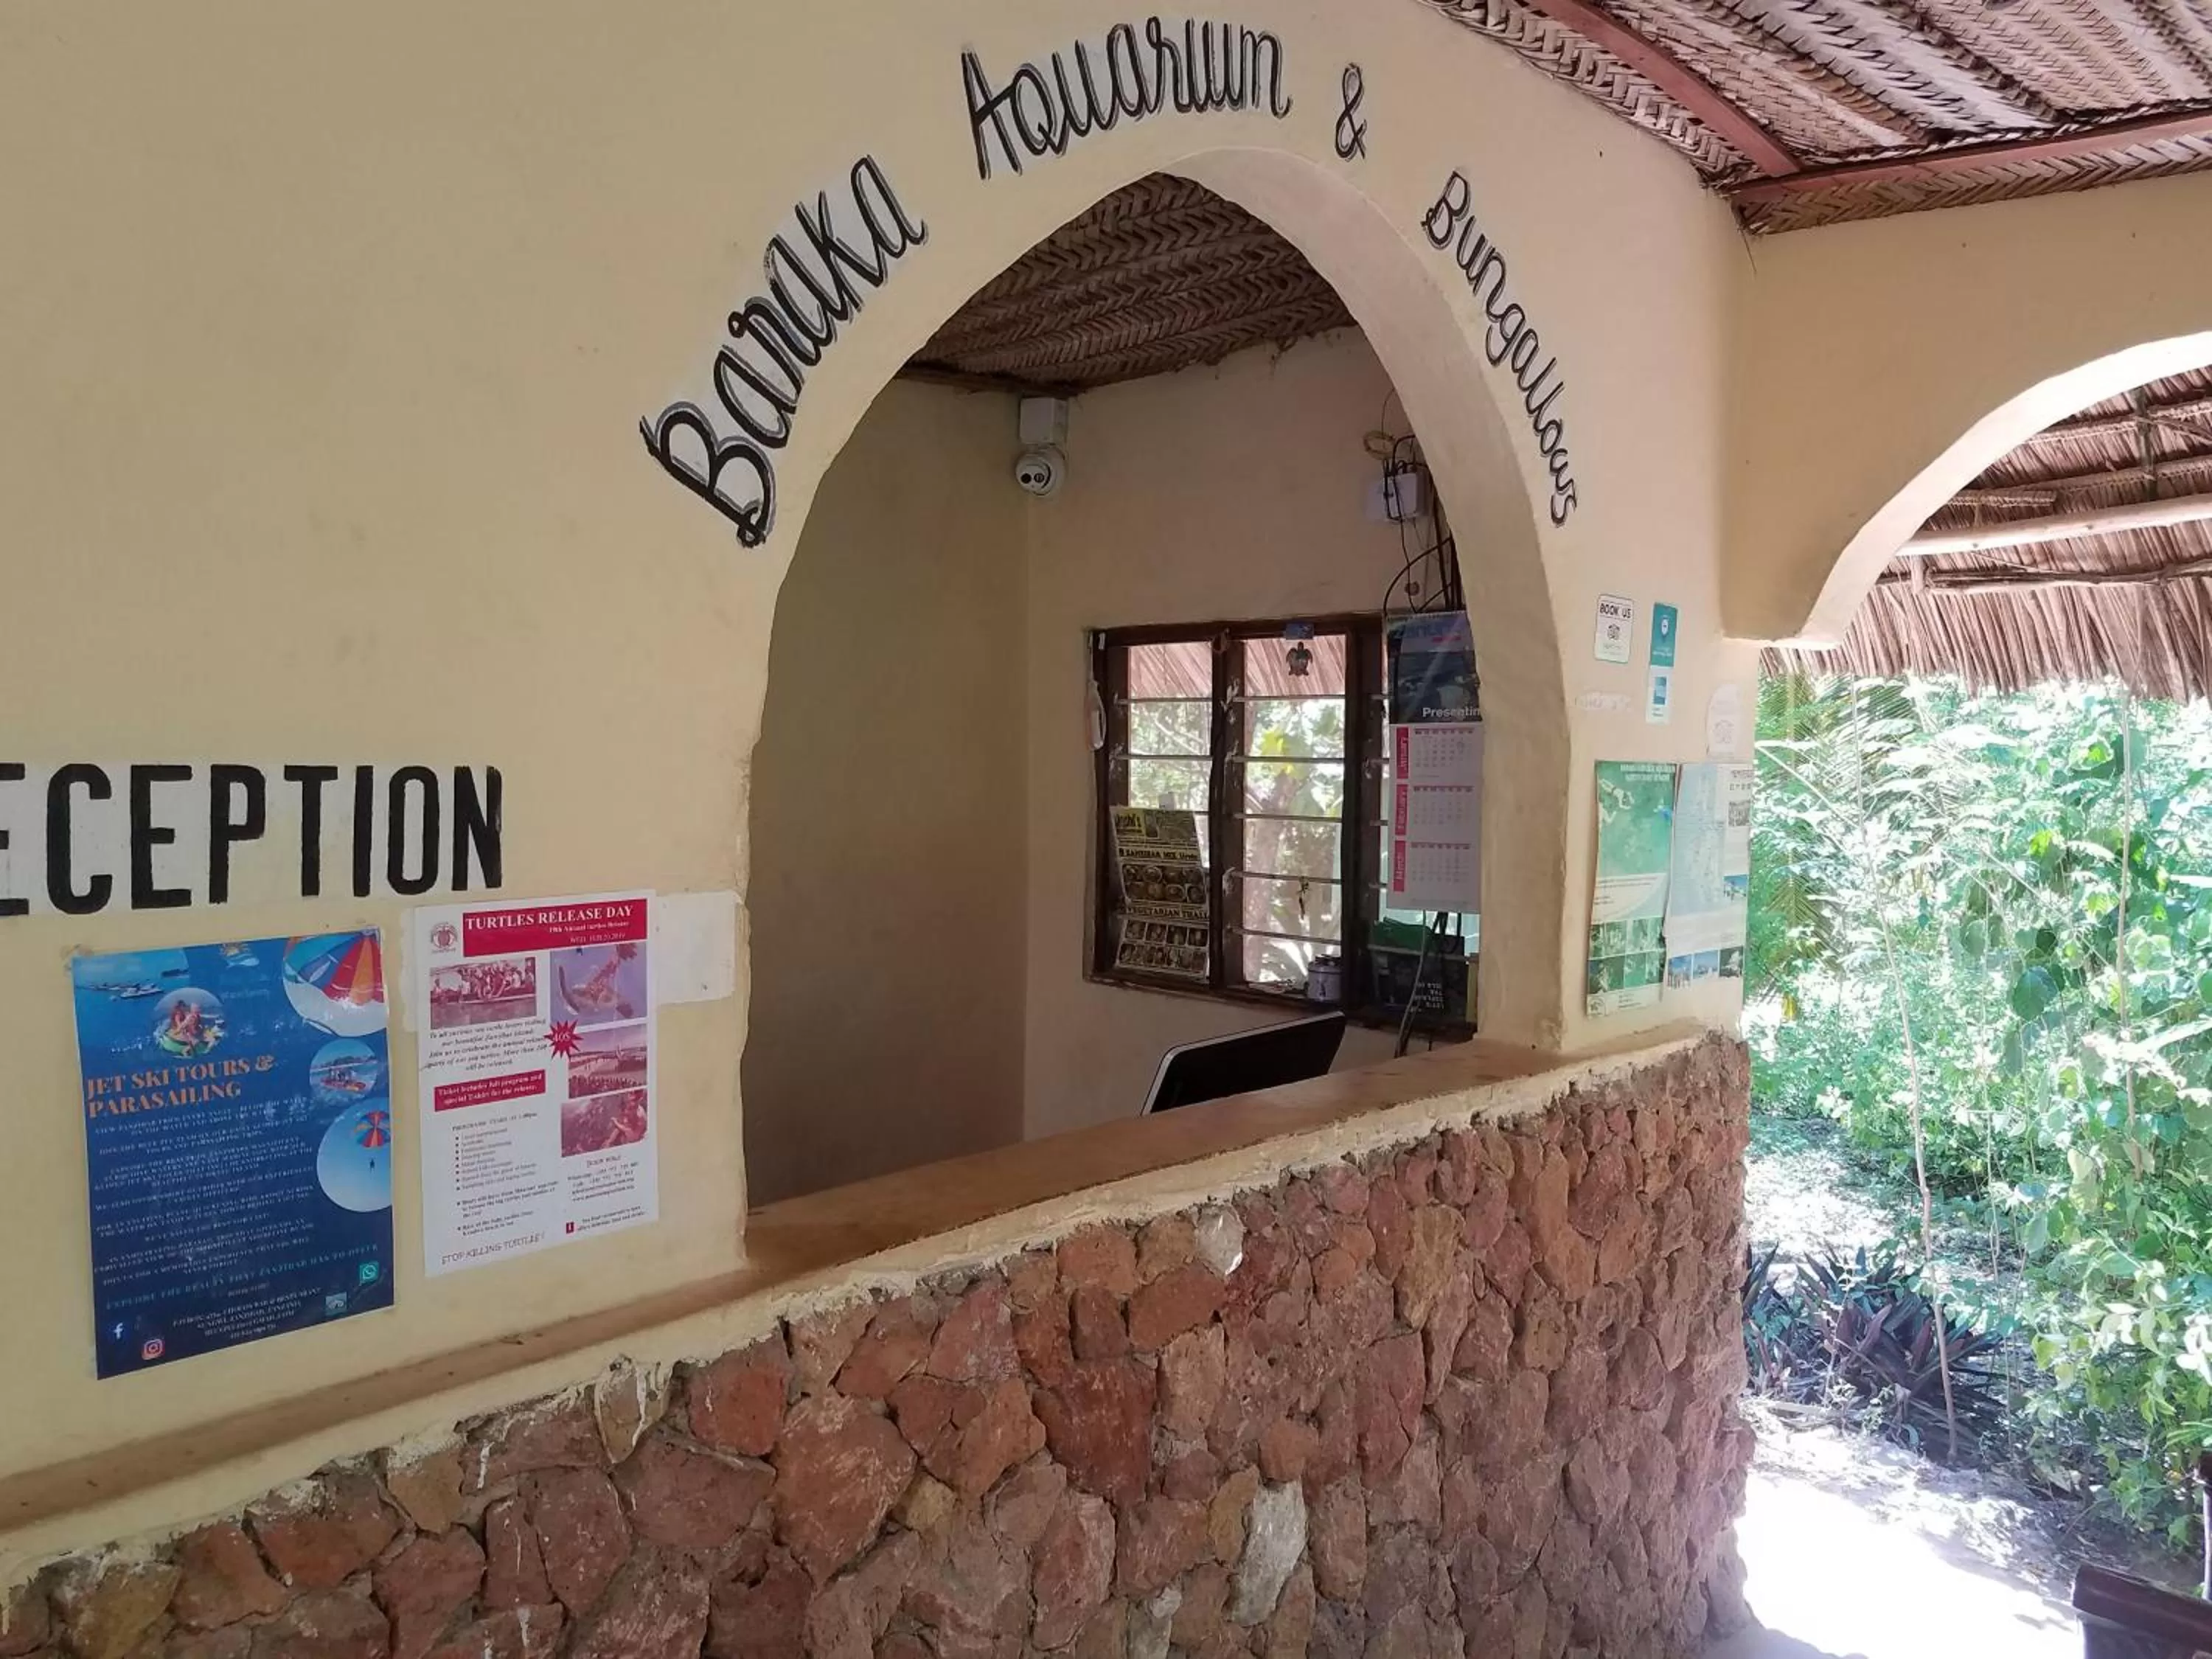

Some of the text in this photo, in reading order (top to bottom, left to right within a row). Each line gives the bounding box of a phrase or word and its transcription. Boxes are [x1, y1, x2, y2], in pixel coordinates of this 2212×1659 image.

[1335, 62, 1368, 161] &
[1599, 602, 1632, 619] BOOK US
[465, 905, 633, 930] TURTLES RELEASE DAY
[86, 1076, 126, 1099] JET
[131, 1068, 170, 1089] SKI
[175, 1058, 251, 1082] TOURS
[88, 1081, 242, 1118] PARASAILING
